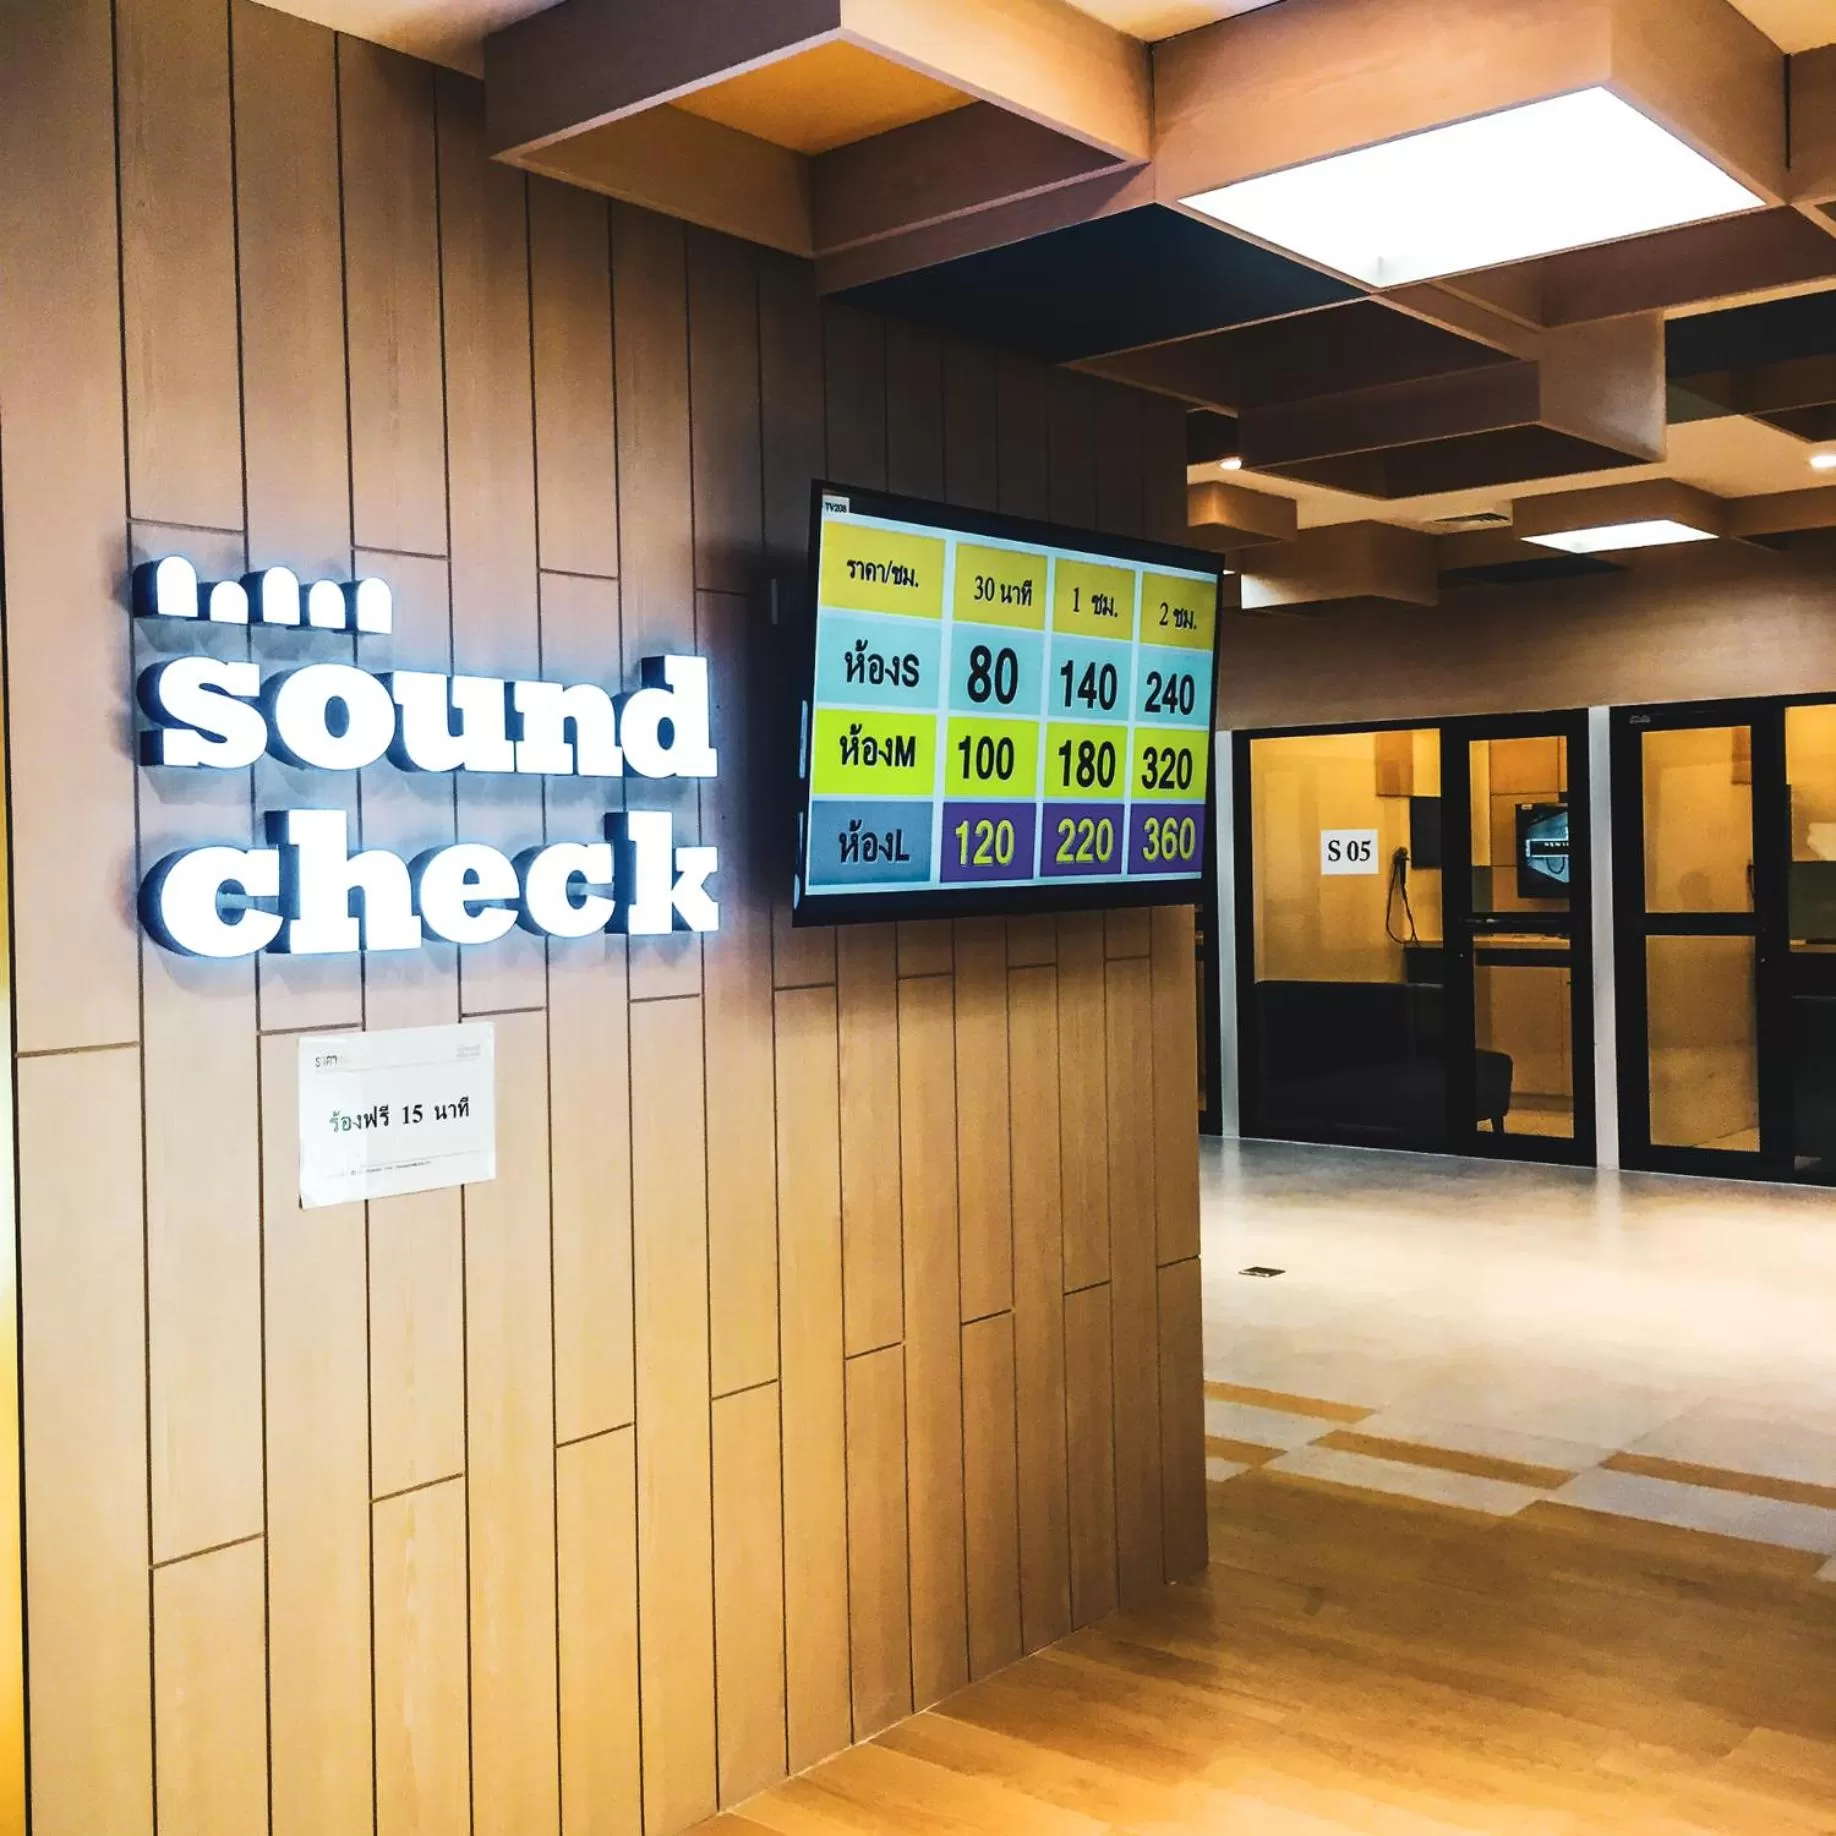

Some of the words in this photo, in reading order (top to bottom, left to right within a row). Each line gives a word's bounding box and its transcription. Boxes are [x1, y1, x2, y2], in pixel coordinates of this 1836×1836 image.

[847, 559, 919, 588] ราคา/ชม.
[973, 576, 995, 602] 30
[1000, 579, 1033, 606] นาที
[1072, 587, 1081, 613] 1
[1091, 593, 1119, 618] ชม.
[1158, 602, 1169, 627] 2
[1172, 607, 1198, 630] ชม.
[844, 640, 920, 688] ห้องS
[966, 645, 1019, 705] 80
[1060, 660, 1118, 711] 140
[1144, 672, 1195, 715] 240
[156, 655, 718, 778] sound
[840, 723, 916, 768] ห้องM
[958, 736, 1014, 780] 100
[1058, 740, 1116, 788] 180
[1141, 747, 1193, 789] 320
[838, 820, 910, 864] ห้องL
[955, 820, 1015, 866] 120
[1056, 817, 1113, 864] 220
[1142, 816, 1196, 862] 360
[1328, 840, 1341, 862] S
[1347, 840, 1371, 862] 05
[158, 809, 719, 957] check
[329, 1104, 389, 1132] ร้องฟรี
[402, 1104, 423, 1125] 15
[434, 1096, 470, 1120] นาที
